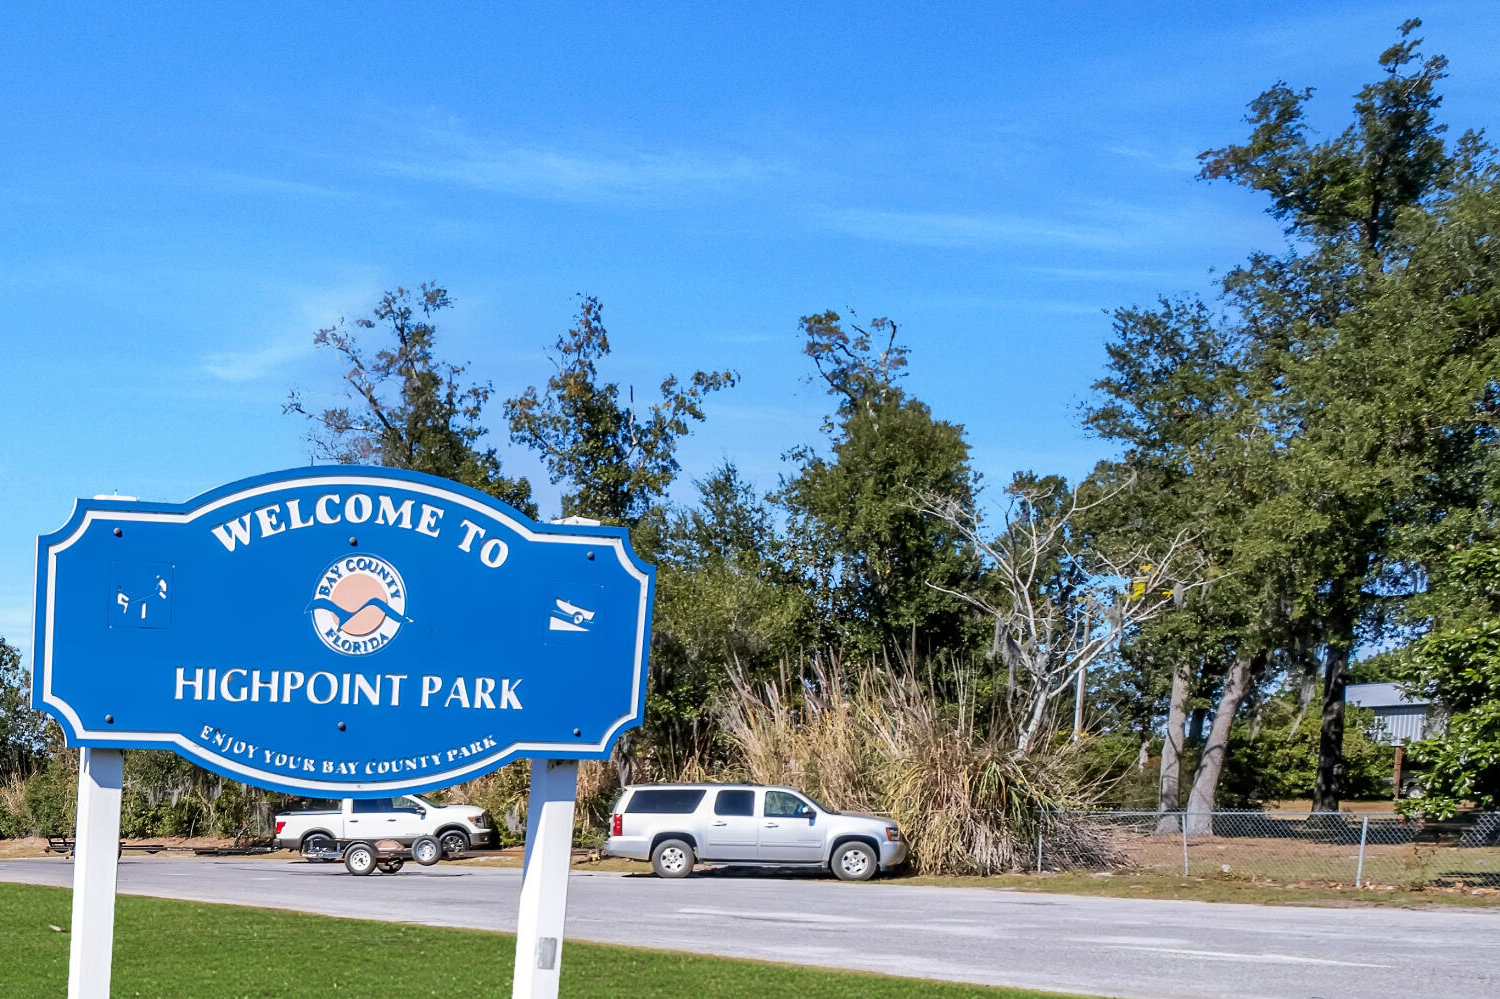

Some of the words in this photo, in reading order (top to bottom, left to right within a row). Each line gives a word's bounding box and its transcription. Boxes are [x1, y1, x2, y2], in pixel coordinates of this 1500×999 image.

[211, 494, 444, 552] WELCOME
[457, 519, 509, 568] TO
[318, 564, 343, 597] BAY
[345, 558, 402, 599] COUNTY
[324, 627, 390, 653] FLORIDA
[174, 667, 408, 706] HIGHPOINT
[420, 675, 523, 710] PARK
[200, 724, 259, 759] ENJOY
[263, 749, 316, 772] YOUR
[321, 760, 358, 775] BAY
[364, 752, 442, 775] COUNTY
[446, 735, 498, 762] PARK
